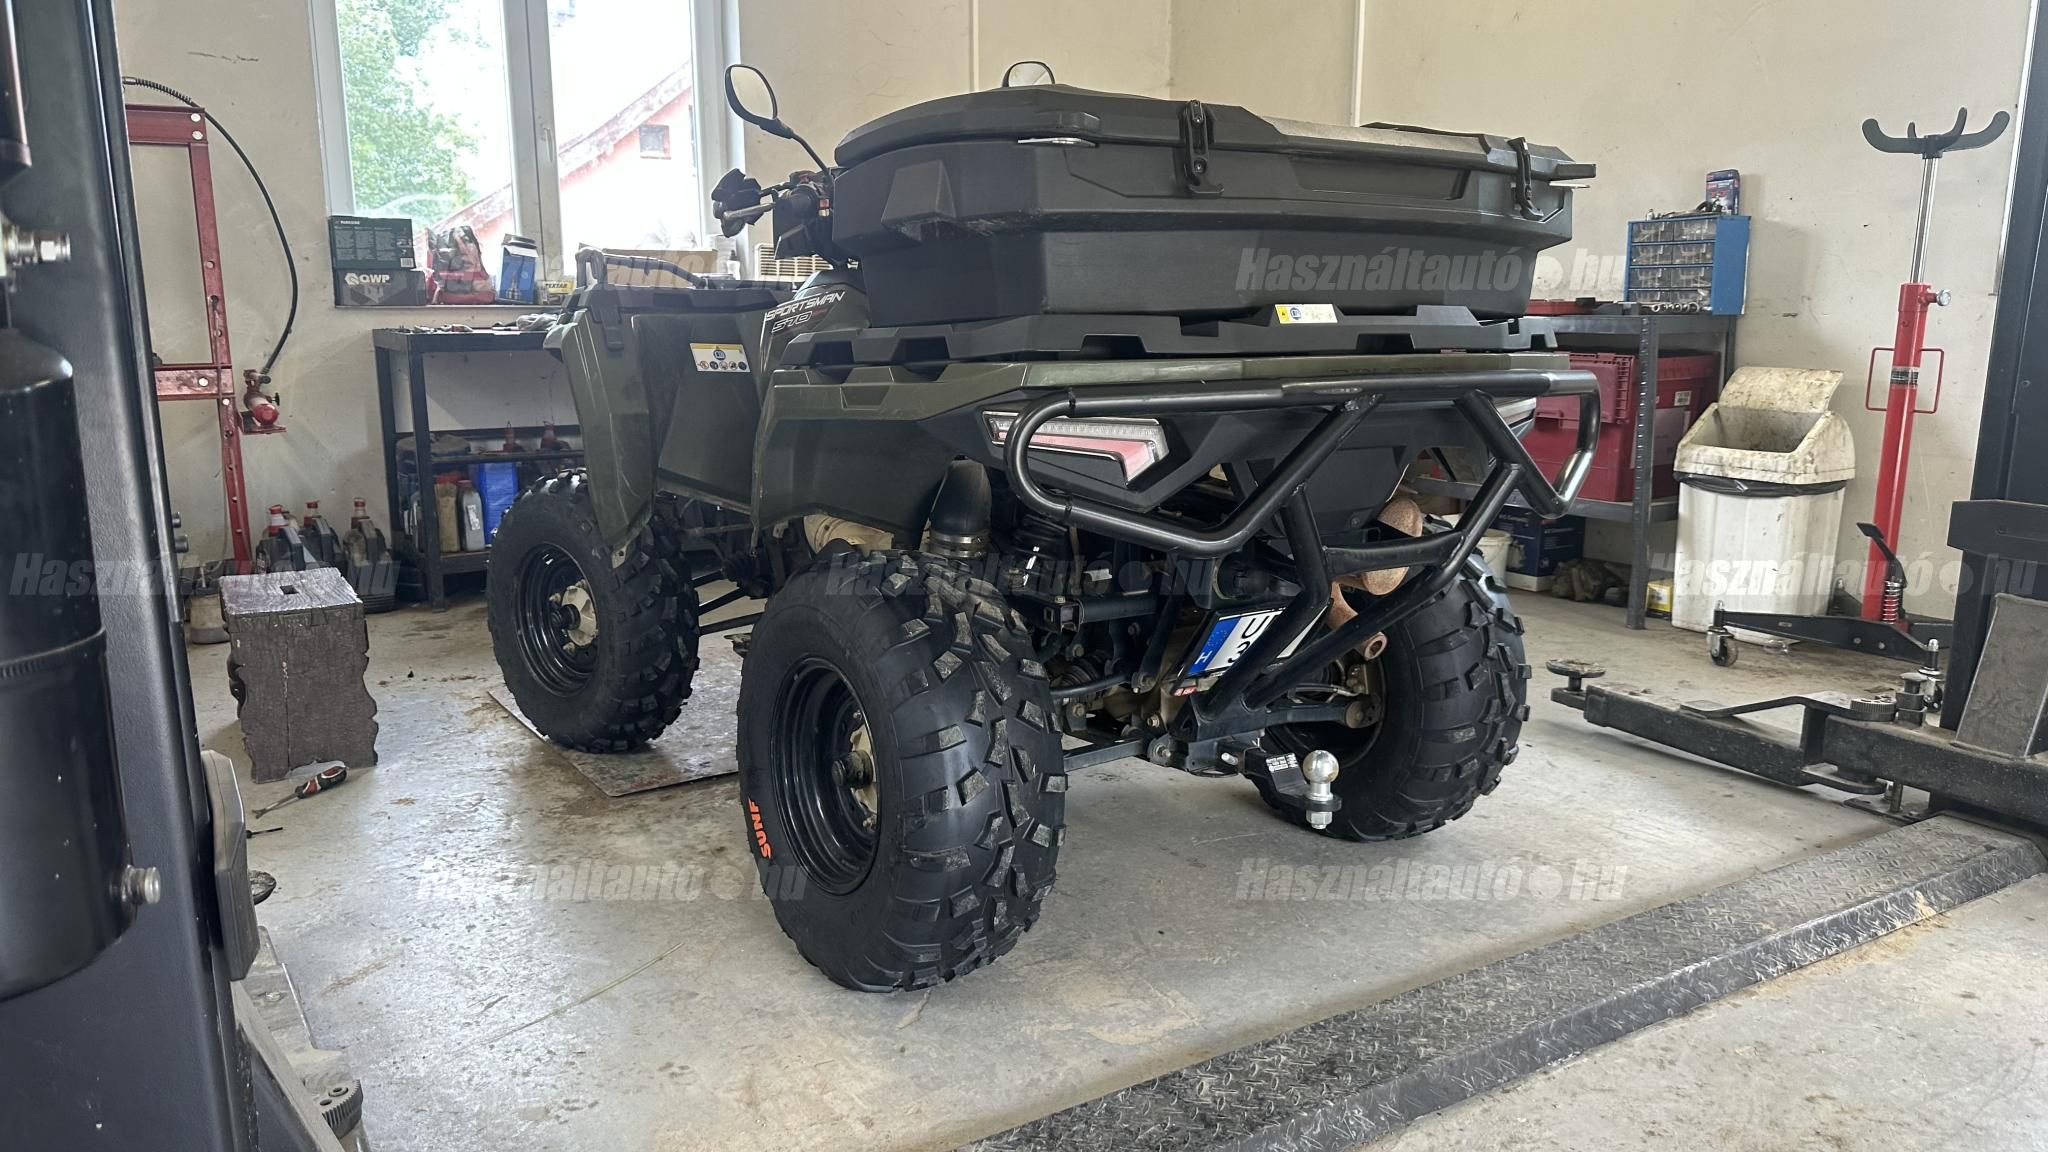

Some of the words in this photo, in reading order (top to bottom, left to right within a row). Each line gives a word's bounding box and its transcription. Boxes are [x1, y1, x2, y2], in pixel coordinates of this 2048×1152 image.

[359, 273, 391, 285] QWP
[766, 291, 846, 322] SPORTSMAN
[771, 310, 813, 333] 570
[1194, 650, 1213, 664] H
[748, 797, 772, 859] SUNF
